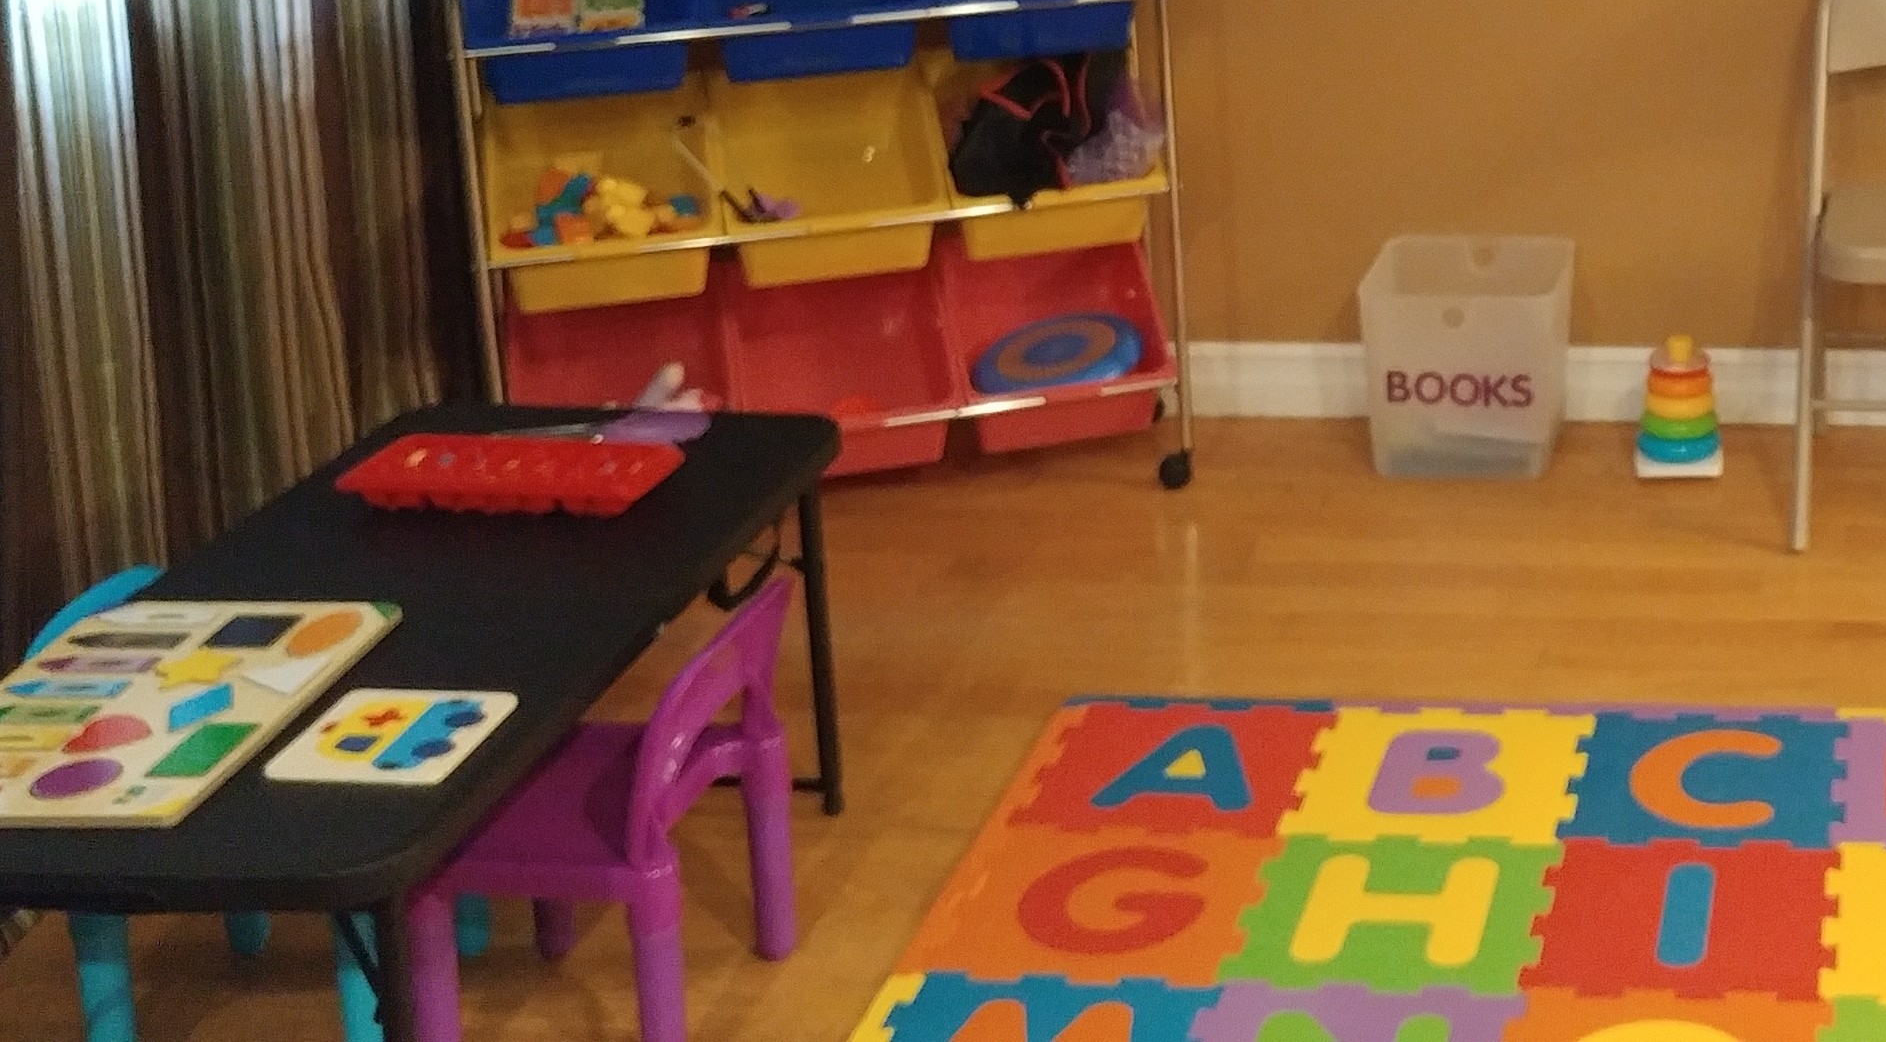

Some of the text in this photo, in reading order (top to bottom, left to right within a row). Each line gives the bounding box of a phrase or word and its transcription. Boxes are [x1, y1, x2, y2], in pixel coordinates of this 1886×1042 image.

[1386, 370, 1536, 409] BOOKS
[1089, 725, 1253, 812] A
[1366, 729, 1506, 815] B
[1629, 730, 1783, 830] C
[1016, 846, 1210, 956] G
[1288, 855, 1500, 967] H
[1655, 863, 1717, 969] I
